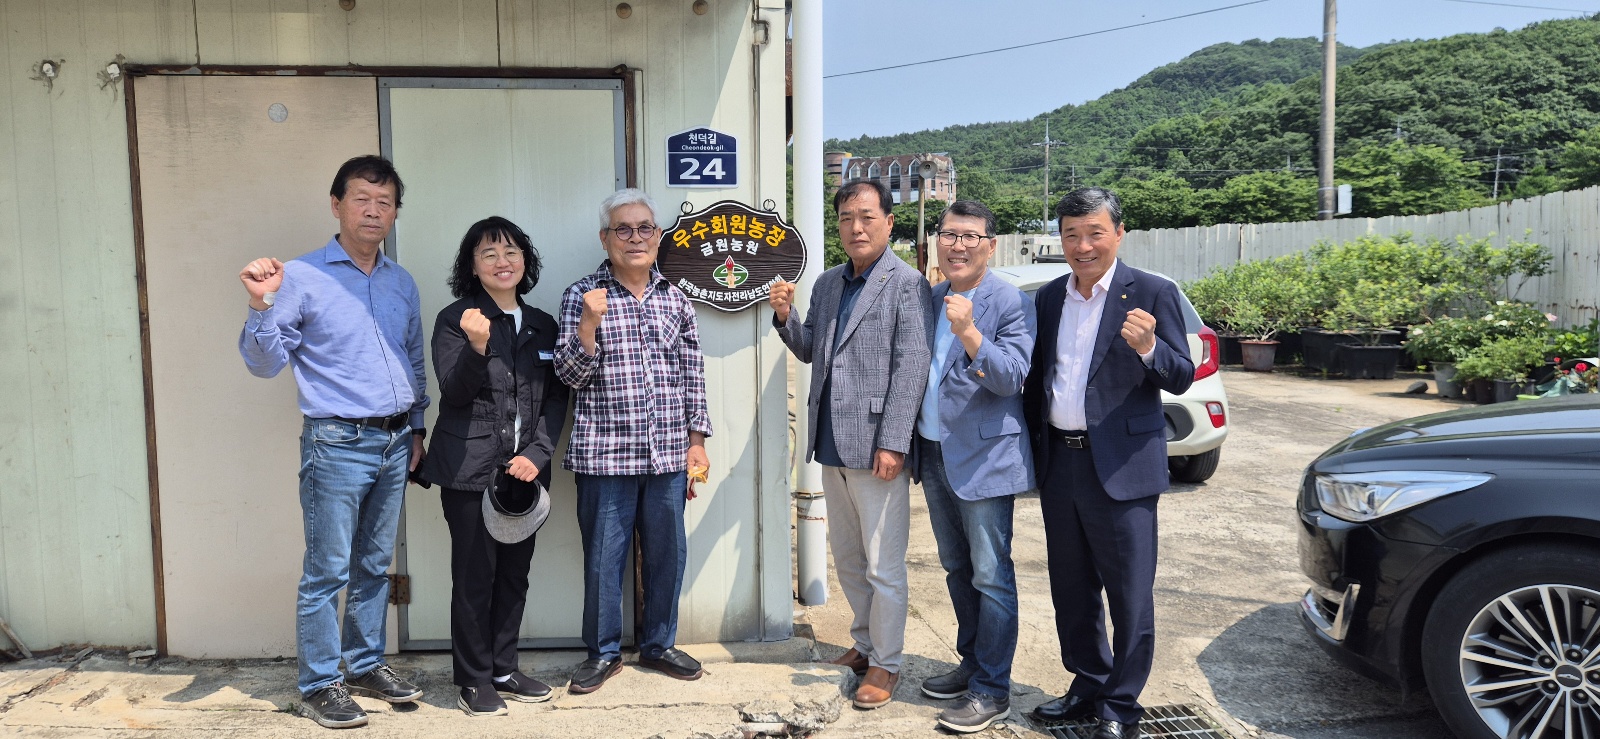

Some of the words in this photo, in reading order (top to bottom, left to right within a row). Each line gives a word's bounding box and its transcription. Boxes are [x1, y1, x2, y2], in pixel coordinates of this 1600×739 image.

[681, 144, 724, 152] Cheondeok-gil
[688, 133, 717, 145] 천덕길
[679, 157, 726, 180] 24
[672, 214, 787, 249] 우수회원농장
[700, 238, 759, 257] 금원농원
